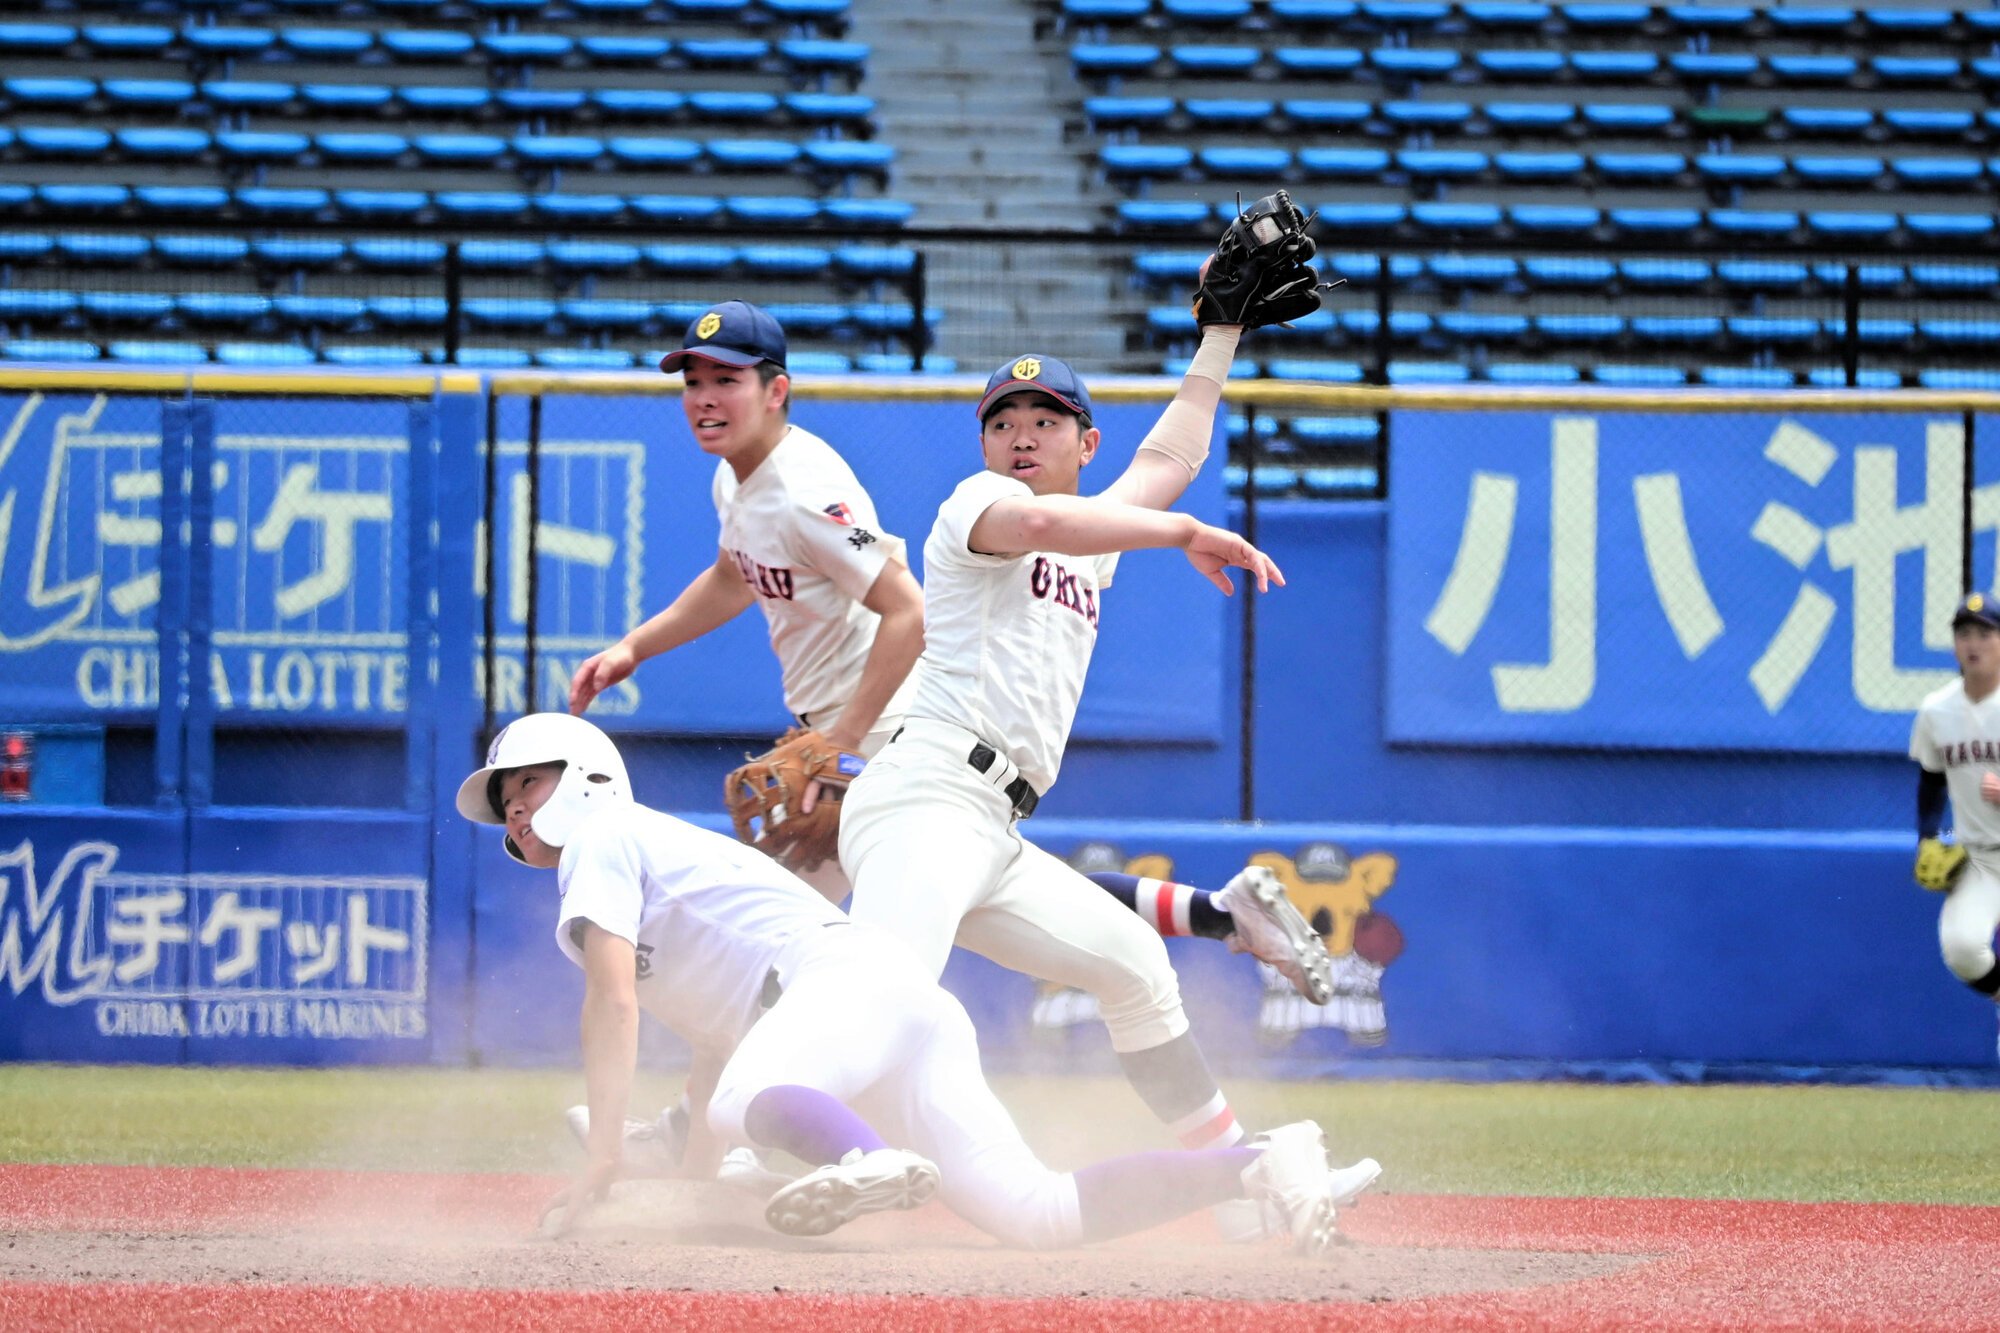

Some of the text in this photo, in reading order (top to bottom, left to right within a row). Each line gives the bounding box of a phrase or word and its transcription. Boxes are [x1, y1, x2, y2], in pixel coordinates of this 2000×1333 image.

[247, 650, 408, 712] LOTTE
[107, 892, 408, 985] チケット
[97, 1000, 426, 1040] CHIBA LOTTE MARINES
